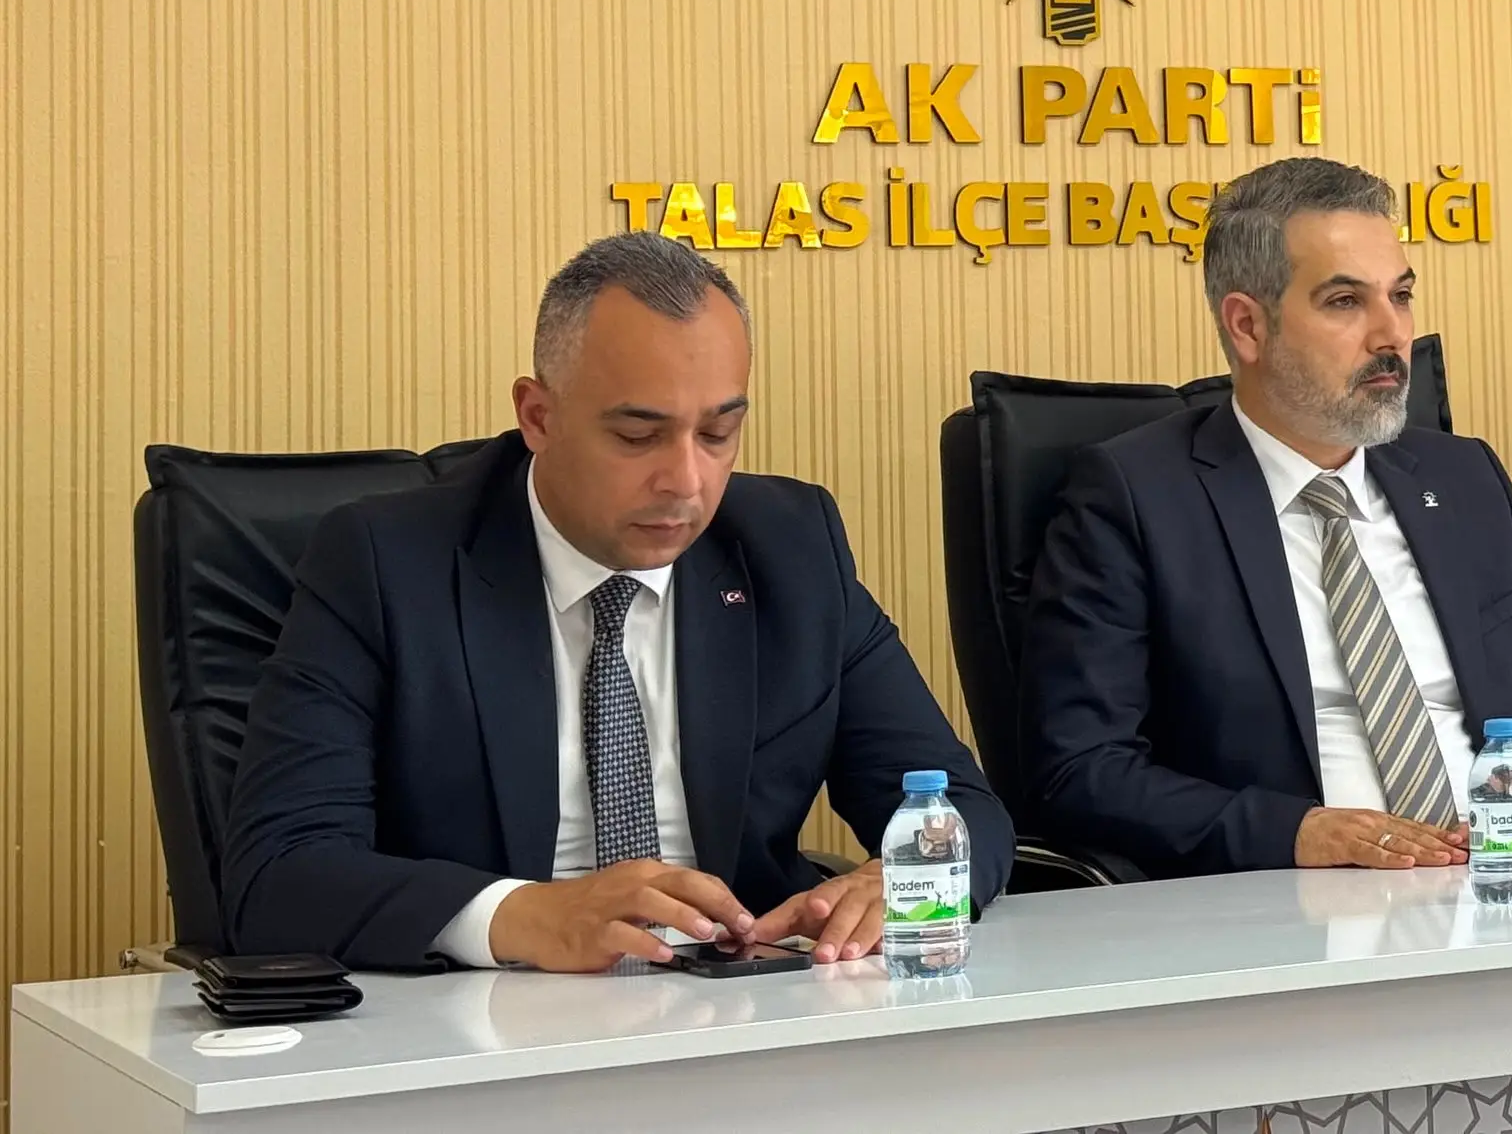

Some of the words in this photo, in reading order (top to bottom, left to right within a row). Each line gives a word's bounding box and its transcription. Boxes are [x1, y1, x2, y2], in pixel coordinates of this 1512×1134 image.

[811, 62, 983, 144] AK
[611, 182, 871, 249] TALAS
[888, 166, 1050, 264] İLÇE
[1067, 164, 1492, 263] BAŞIĞI
[891, 880, 934, 891] badem
